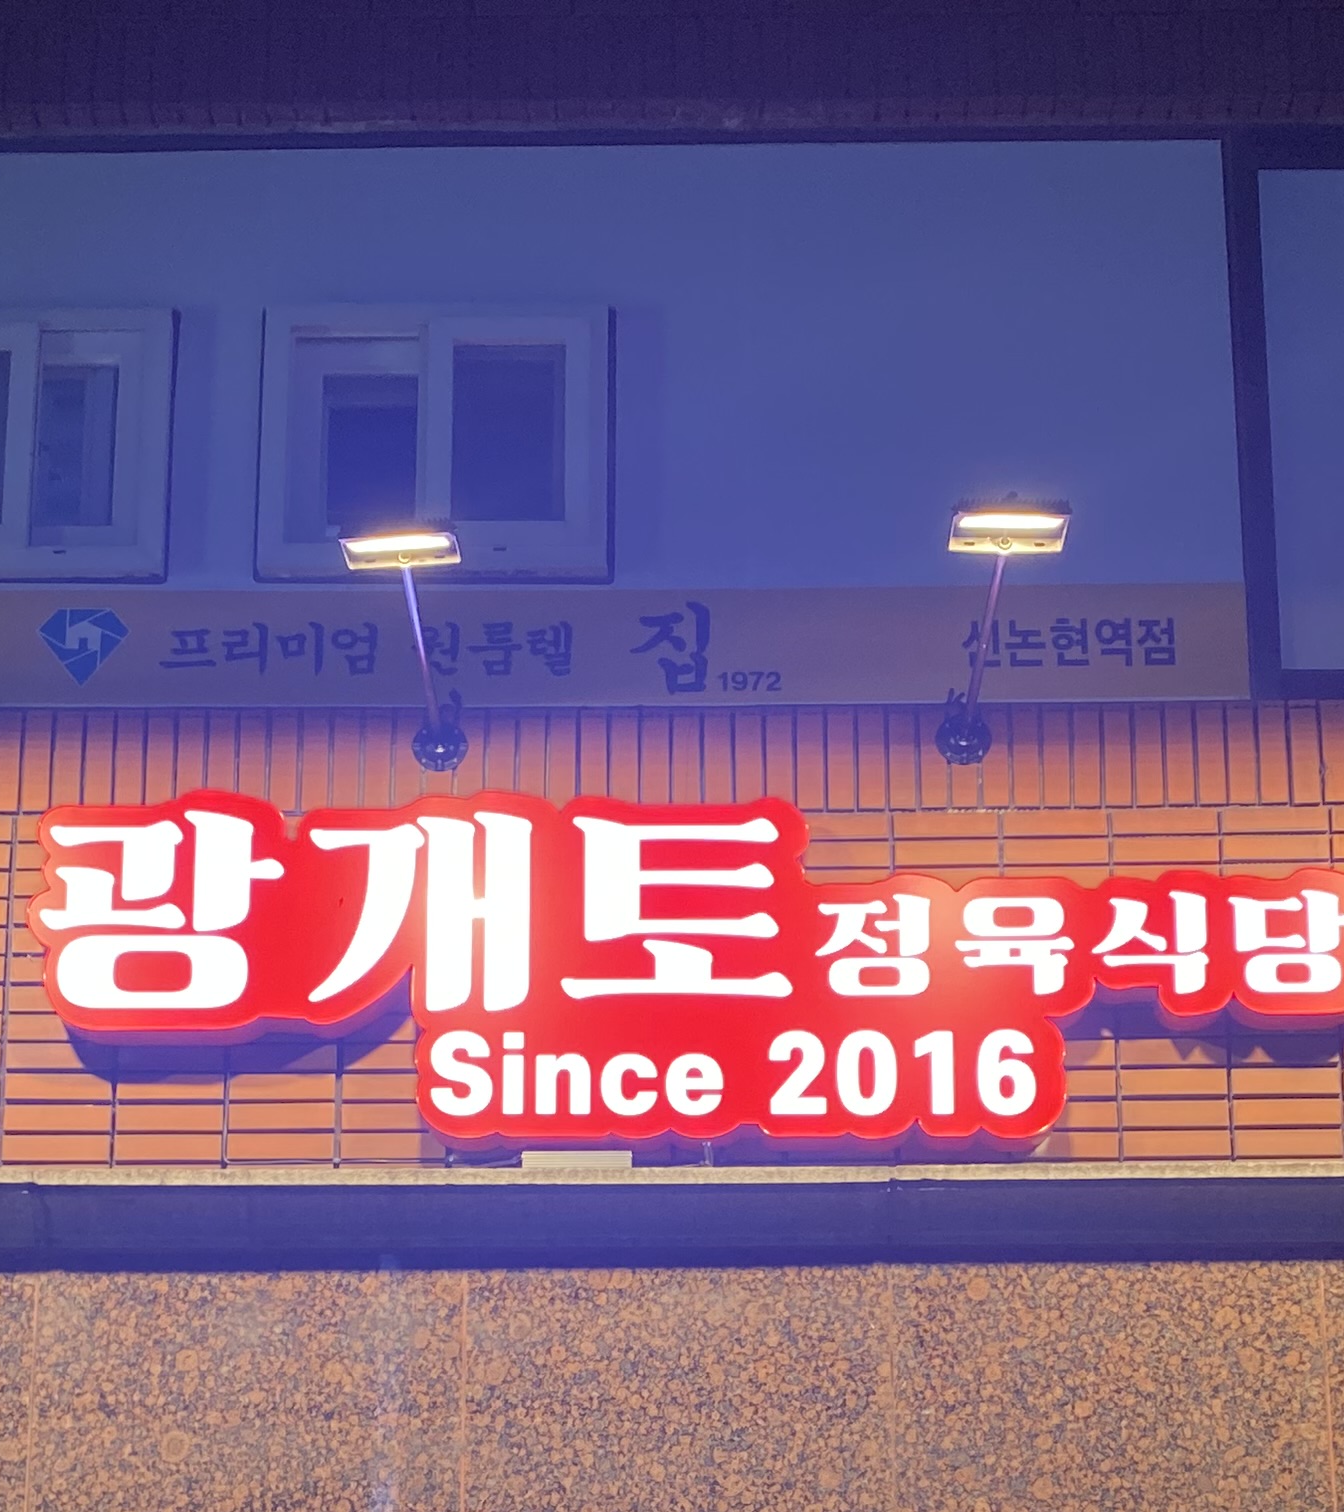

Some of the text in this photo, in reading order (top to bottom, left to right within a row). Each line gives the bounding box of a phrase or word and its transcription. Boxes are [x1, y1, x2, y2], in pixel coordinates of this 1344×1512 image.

[159, 626, 381, 679] 프리미엄
[628, 599, 714, 697] 집
[716, 670, 783, 692] 1972
[959, 616, 1178, 671] 신논현역점
[36, 805, 799, 1016] 광개토
[428, 1025, 1038, 1120] Since 2016
